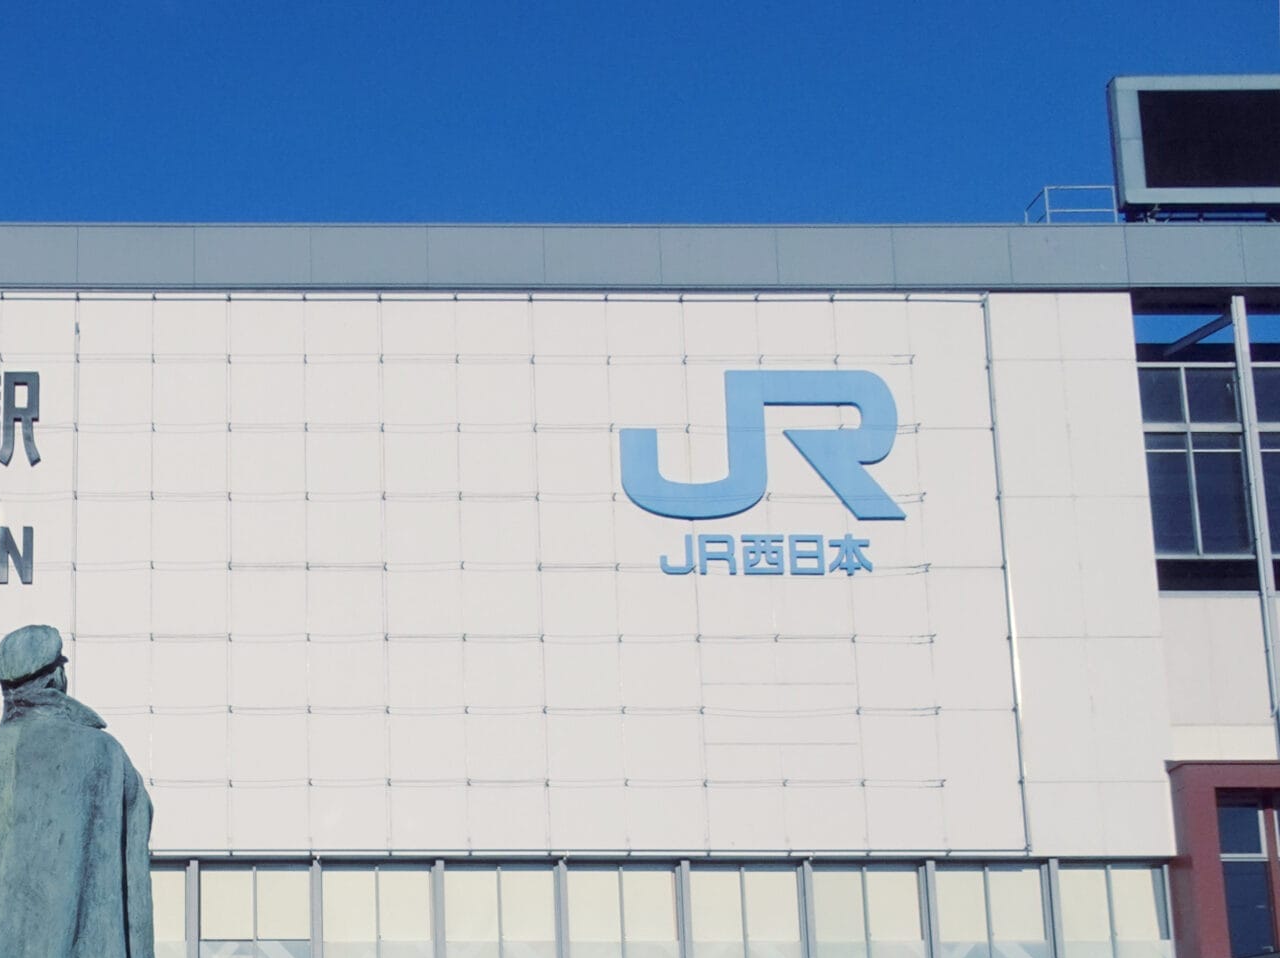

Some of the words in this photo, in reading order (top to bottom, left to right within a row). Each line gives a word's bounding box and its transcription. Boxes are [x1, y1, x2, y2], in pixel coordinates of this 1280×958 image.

[620, 370, 907, 521] JR
[660, 534, 873, 576] JR西日本
